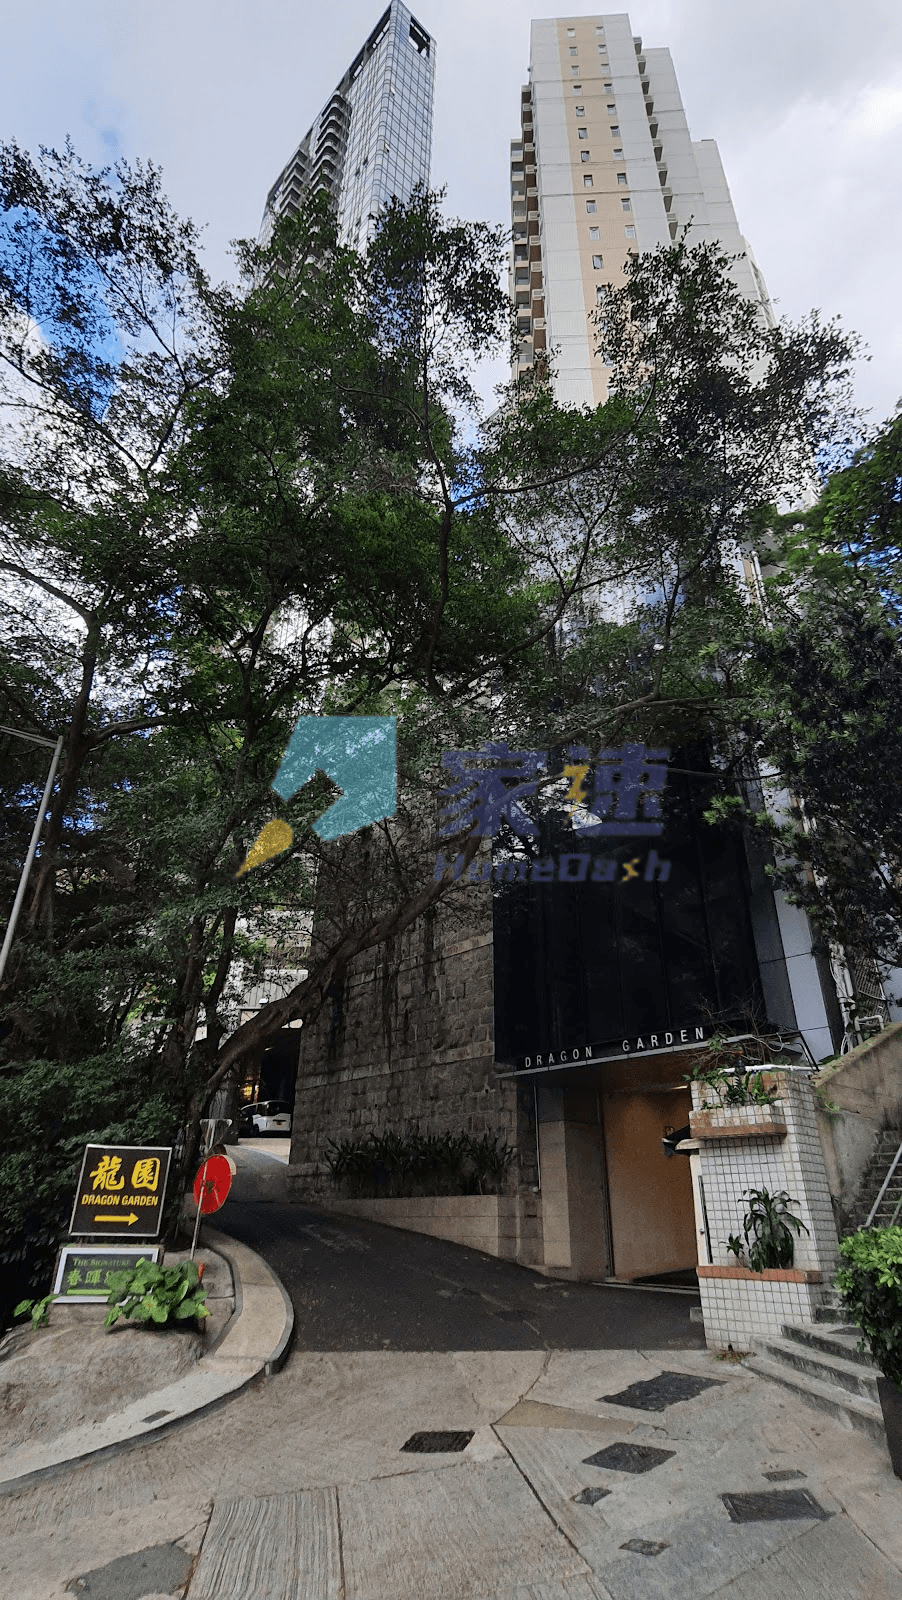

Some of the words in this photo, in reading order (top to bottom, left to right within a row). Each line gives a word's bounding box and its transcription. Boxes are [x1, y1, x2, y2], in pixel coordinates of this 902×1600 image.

[525, 1046, 592, 1068] DRAGON
[622, 1027, 704, 1052] GARDEN
[89, 1155, 161, 1191] 龍園
[81, 1194, 120, 1206] DRAGON
[121, 1195, 159, 1206] GARDEN
